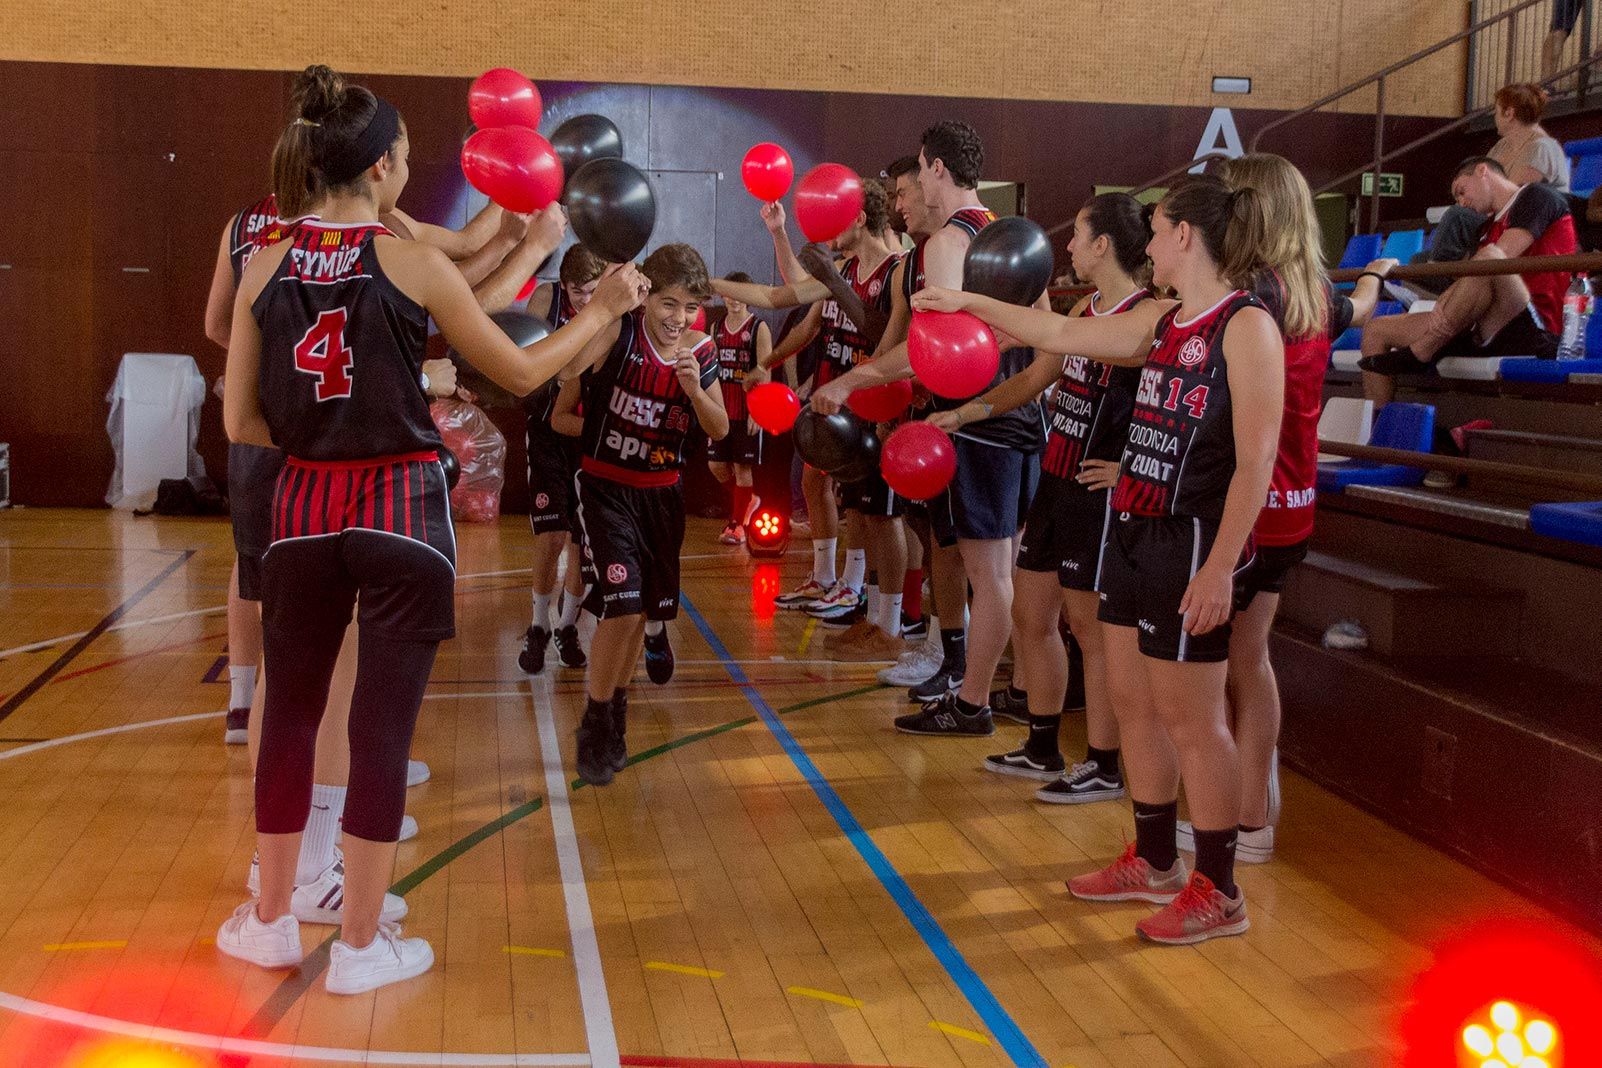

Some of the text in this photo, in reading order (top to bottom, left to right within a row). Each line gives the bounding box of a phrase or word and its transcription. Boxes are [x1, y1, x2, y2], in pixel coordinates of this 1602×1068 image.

[1187, 107, 1245, 174] A
[294, 306, 354, 402] 4
[609, 385, 666, 428] UESC
[1163, 377, 1209, 419] 14
[1061, 559, 1080, 571] vive
[1138, 618, 1156, 634] vive
